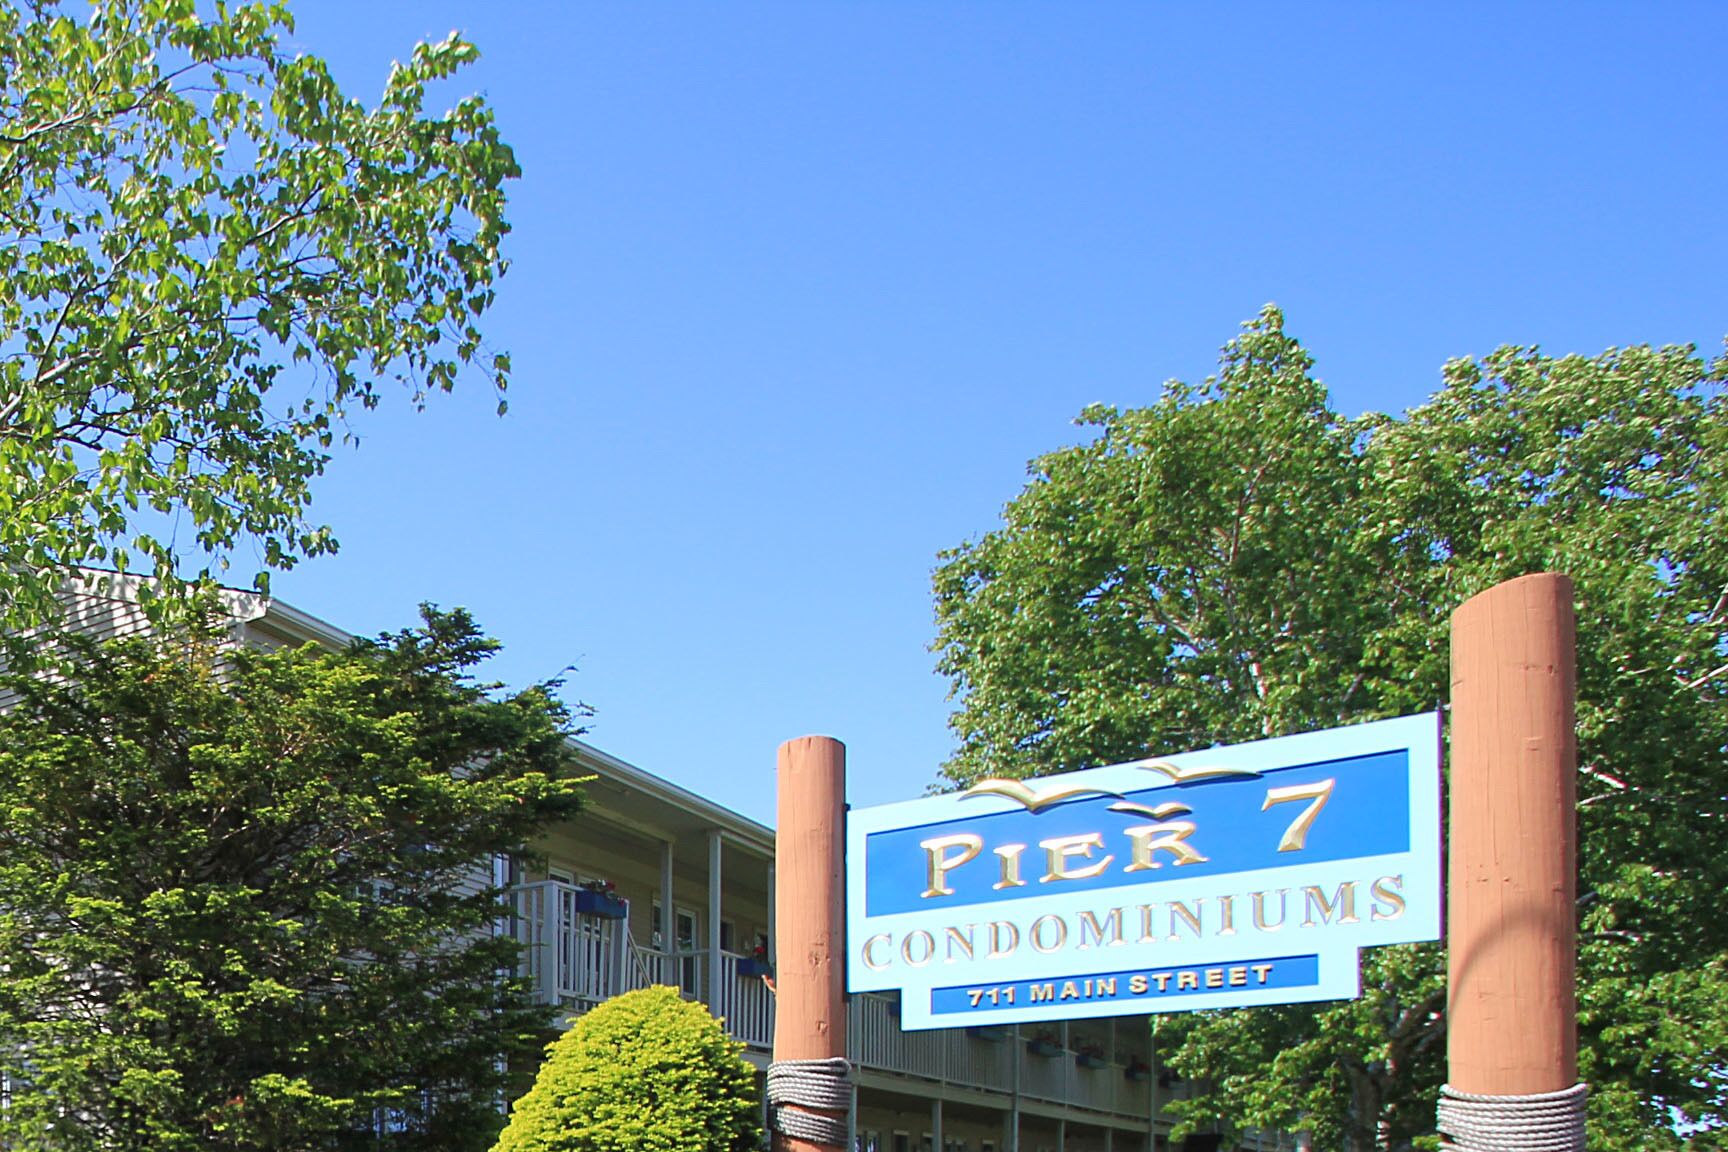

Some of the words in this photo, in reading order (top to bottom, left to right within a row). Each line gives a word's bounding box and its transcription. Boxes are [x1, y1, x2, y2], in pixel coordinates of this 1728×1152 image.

[919, 821, 1209, 898] PIER
[1261, 778, 1336, 852] 7
[860, 874, 1406, 970] CONDOMINIUMS
[967, 987, 1016, 1007] 711
[1030, 977, 1118, 1003] MAIN
[1128, 964, 1273, 995] STREET
